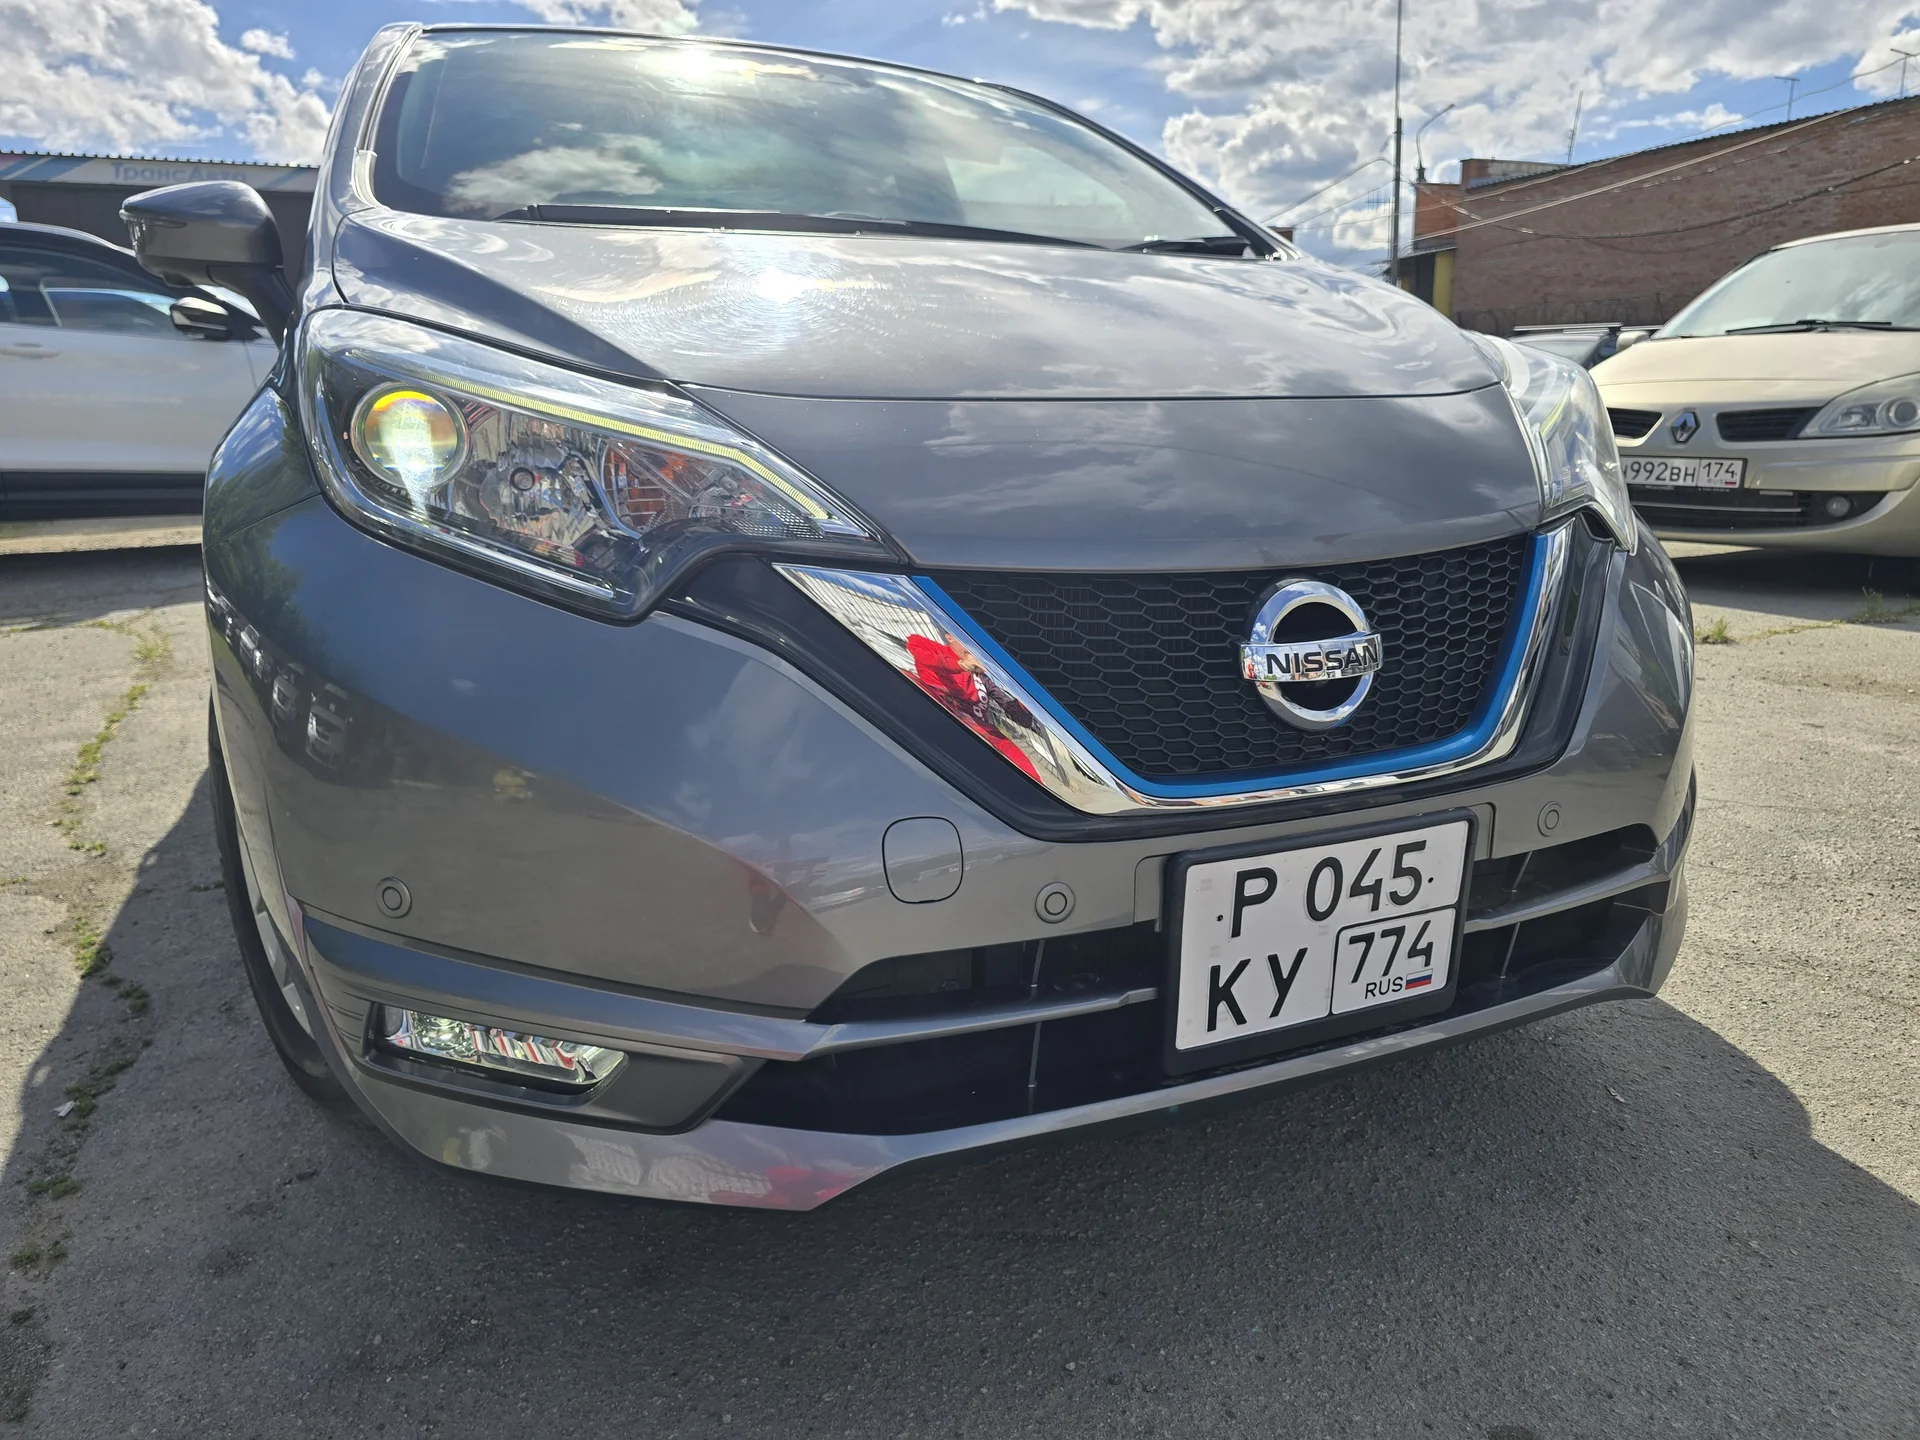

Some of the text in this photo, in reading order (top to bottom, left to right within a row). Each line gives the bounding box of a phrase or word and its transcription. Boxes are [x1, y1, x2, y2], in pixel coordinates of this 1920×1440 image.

[110, 162, 247, 182] ТрансАвто
[1702, 462, 1736, 479] 174
[1265, 643, 1378, 675] NISSAN
[1230, 839, 1427, 938] Р 045
[1206, 919, 1434, 1032] КУ 774
[1364, 976, 1403, 1000] RUS
